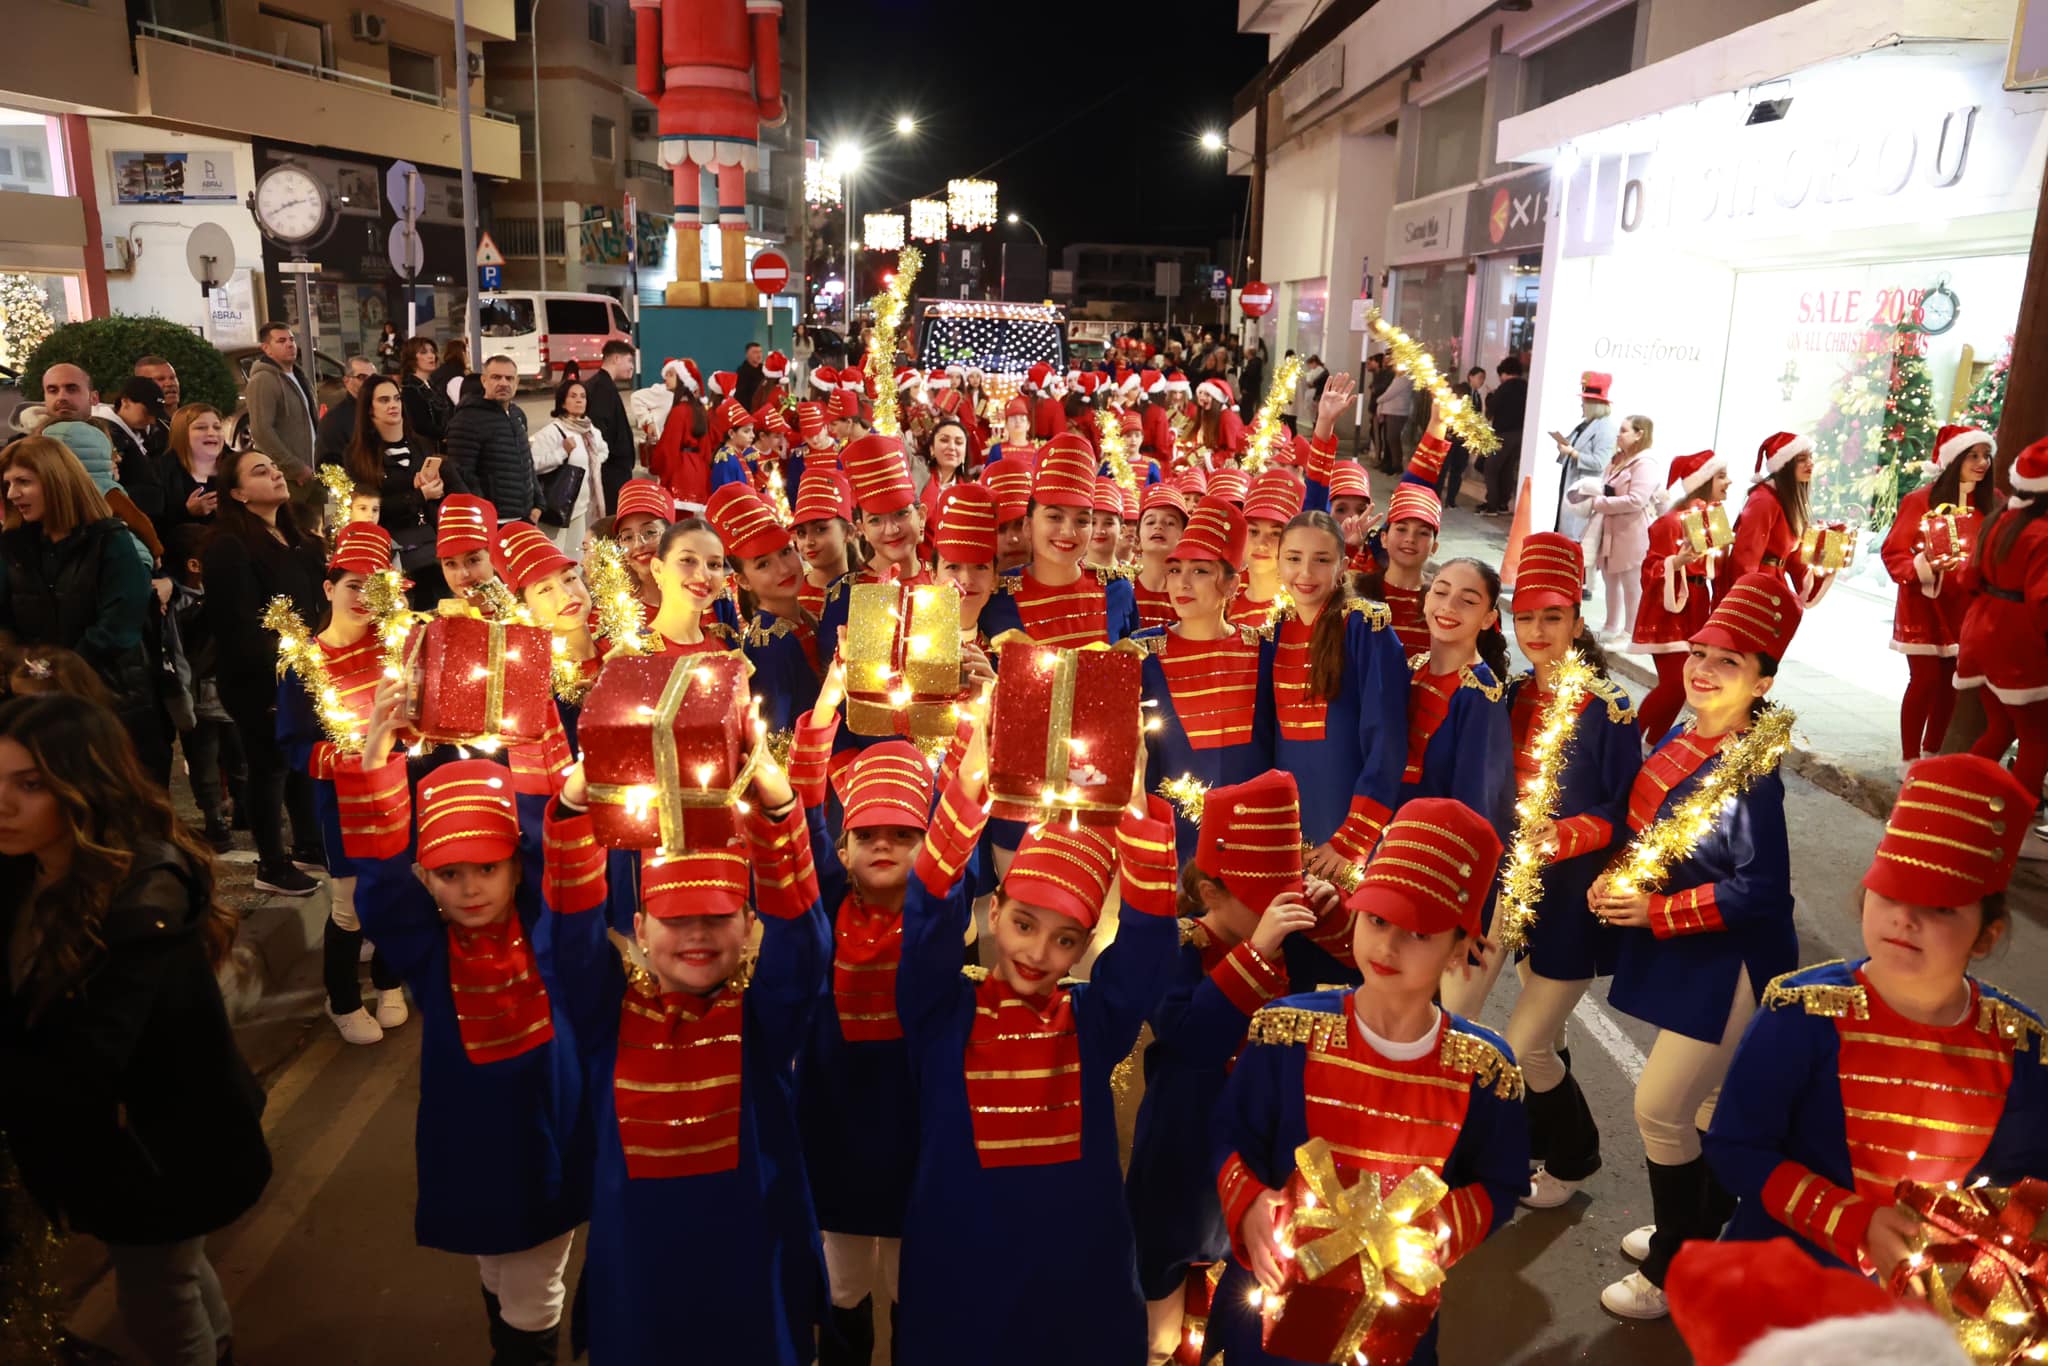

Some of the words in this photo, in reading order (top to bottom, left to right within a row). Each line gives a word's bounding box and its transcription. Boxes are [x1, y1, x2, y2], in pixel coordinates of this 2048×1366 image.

[1620, 104, 1983, 233] ONSIFOROU
[1509, 191, 1549, 230] XI
[485, 266, 497, 281] P
[1213, 269, 1225, 284] P
[212, 310, 242, 320] ABRAJ
[1797, 289, 1862, 324] SALE
[1871, 287, 1927, 325] 20%
[1594, 336, 1702, 367] Onisiforou
